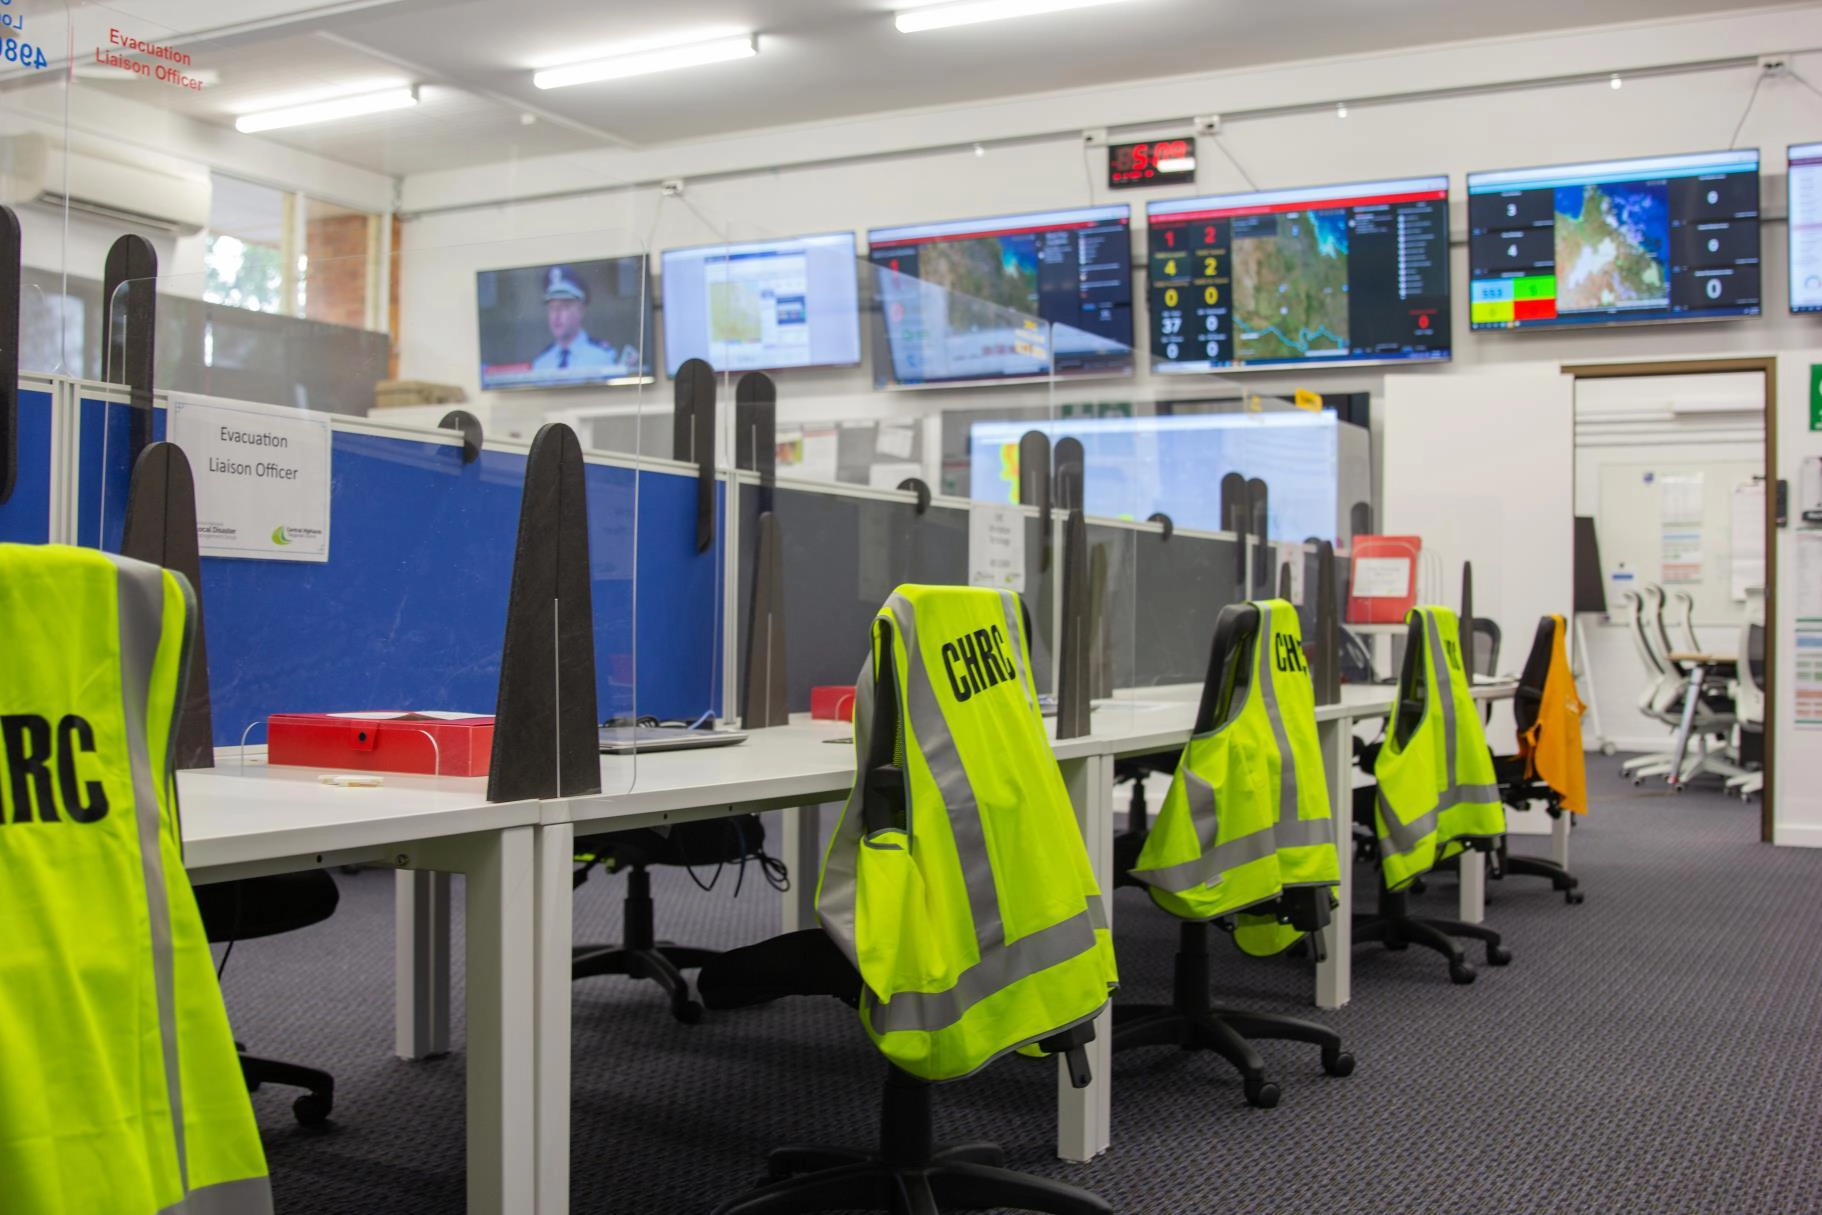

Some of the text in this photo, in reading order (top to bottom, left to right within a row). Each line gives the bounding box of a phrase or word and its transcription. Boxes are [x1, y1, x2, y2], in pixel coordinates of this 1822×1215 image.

[109, 28, 191, 66] Evacuation
[95, 47, 203, 91] Liaison Officer
[1164, 231, 1175, 247] 1
[1204, 226, 1216, 244] 2
[1164, 260, 1177, 276] 4
[1204, 257, 1217, 276] 2
[1164, 288, 1178, 307] 0
[1204, 286, 1218, 305] 0
[1706, 278, 1722, 299] 0
[1161, 317, 1182, 334] 37
[1205, 315, 1219, 332] 0
[1166, 342, 1179, 359] 0
[1206, 341, 1219, 357] 0
[220, 426, 288, 448] Evacuation
[208, 457, 299, 480] Liaison Officer
[941, 624, 1017, 703] CHRC
[0, 714, 110, 825] RC
